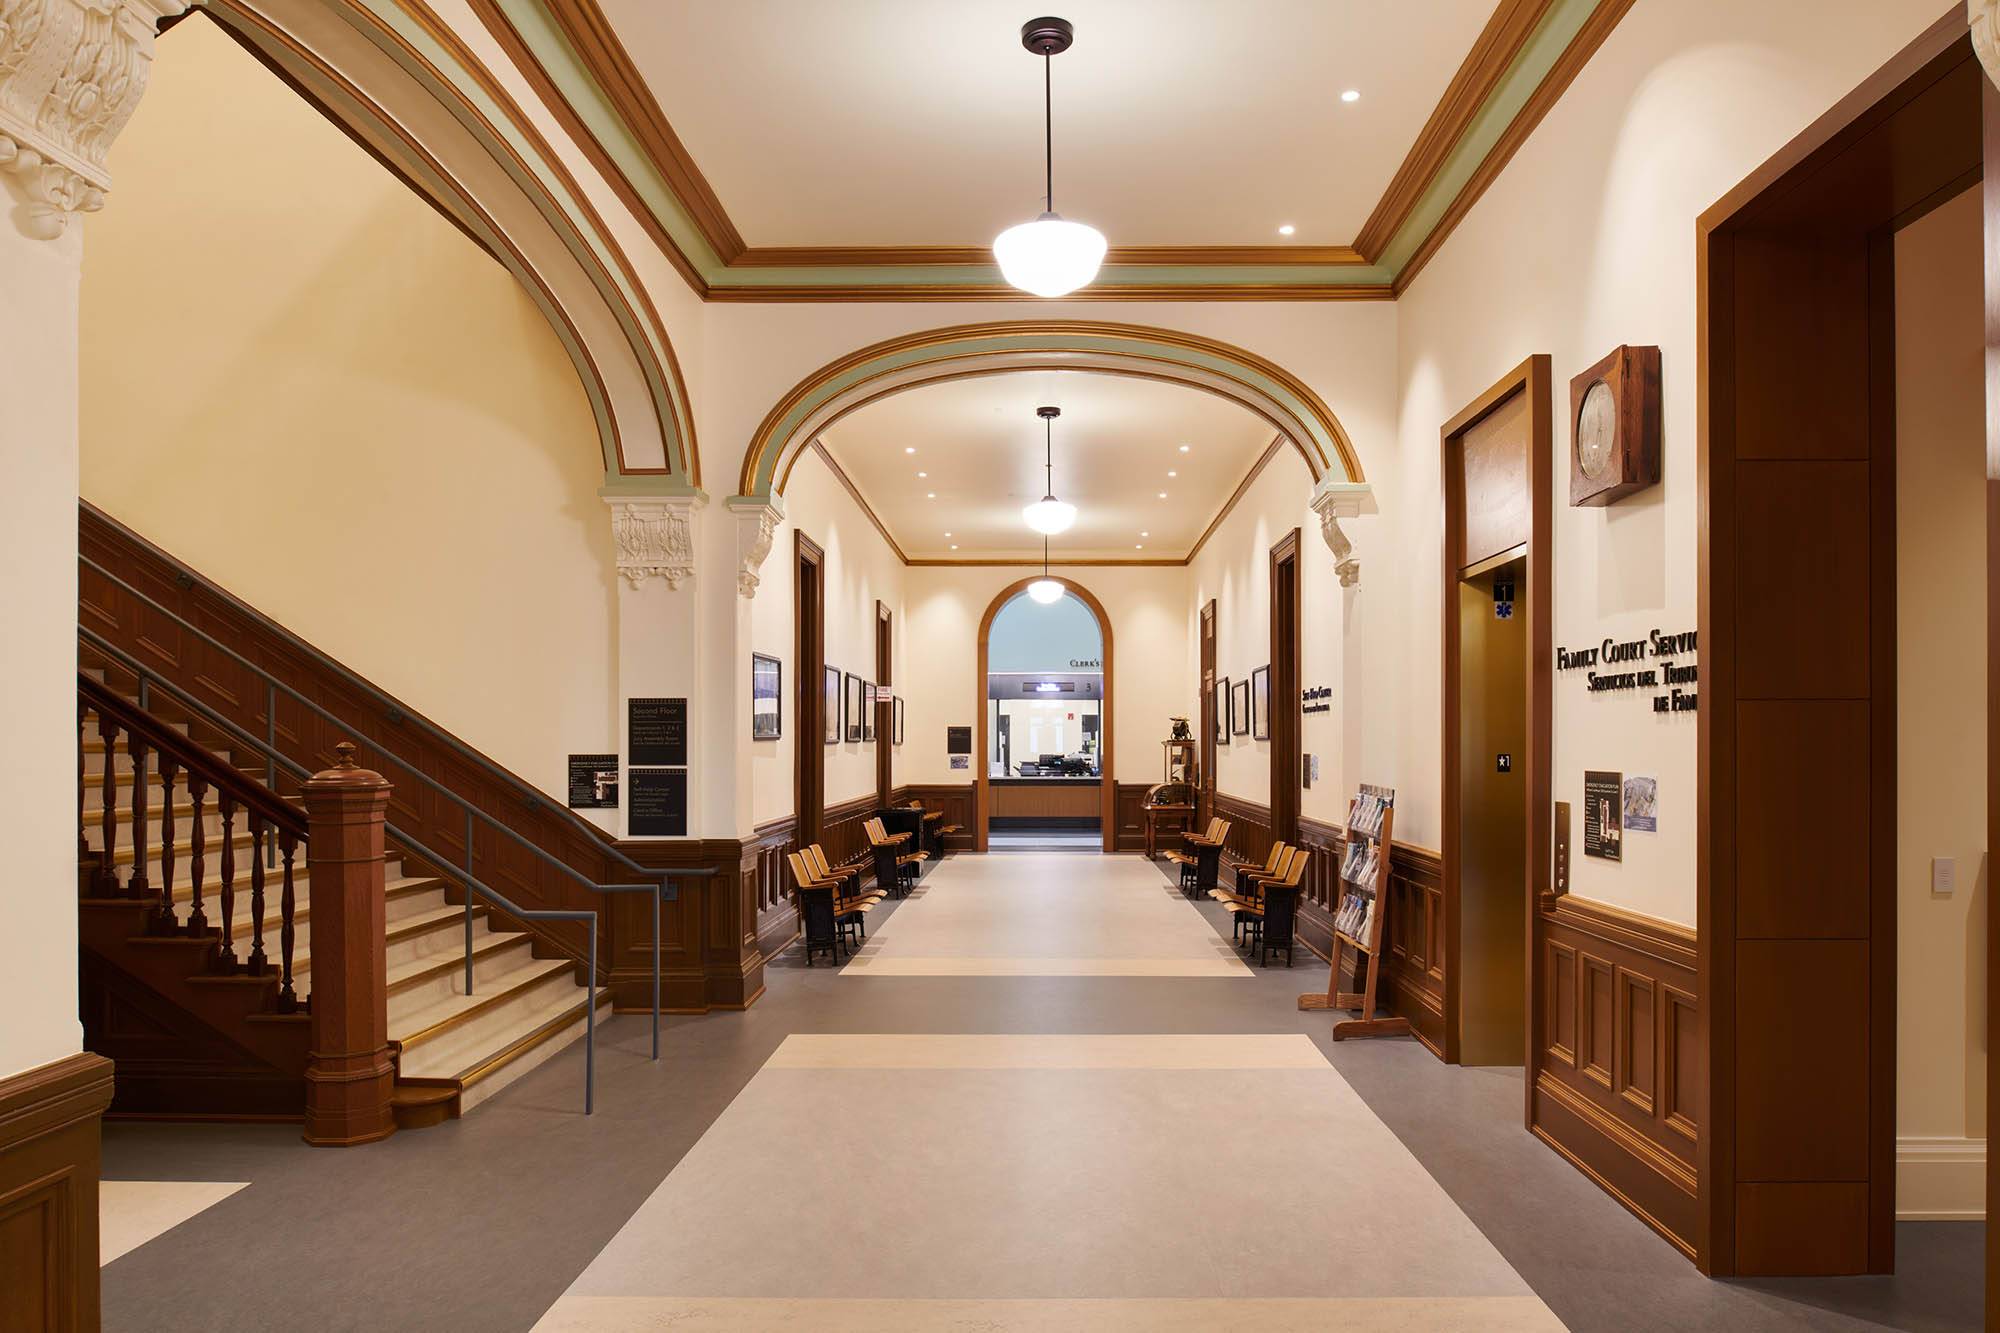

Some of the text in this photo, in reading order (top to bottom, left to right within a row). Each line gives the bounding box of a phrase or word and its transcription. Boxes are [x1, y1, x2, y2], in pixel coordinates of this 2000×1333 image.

[1557, 647, 1599, 670] FAMILY
[1601, 638, 1648, 664] COURT
[1653, 695, 1670, 712] DE
